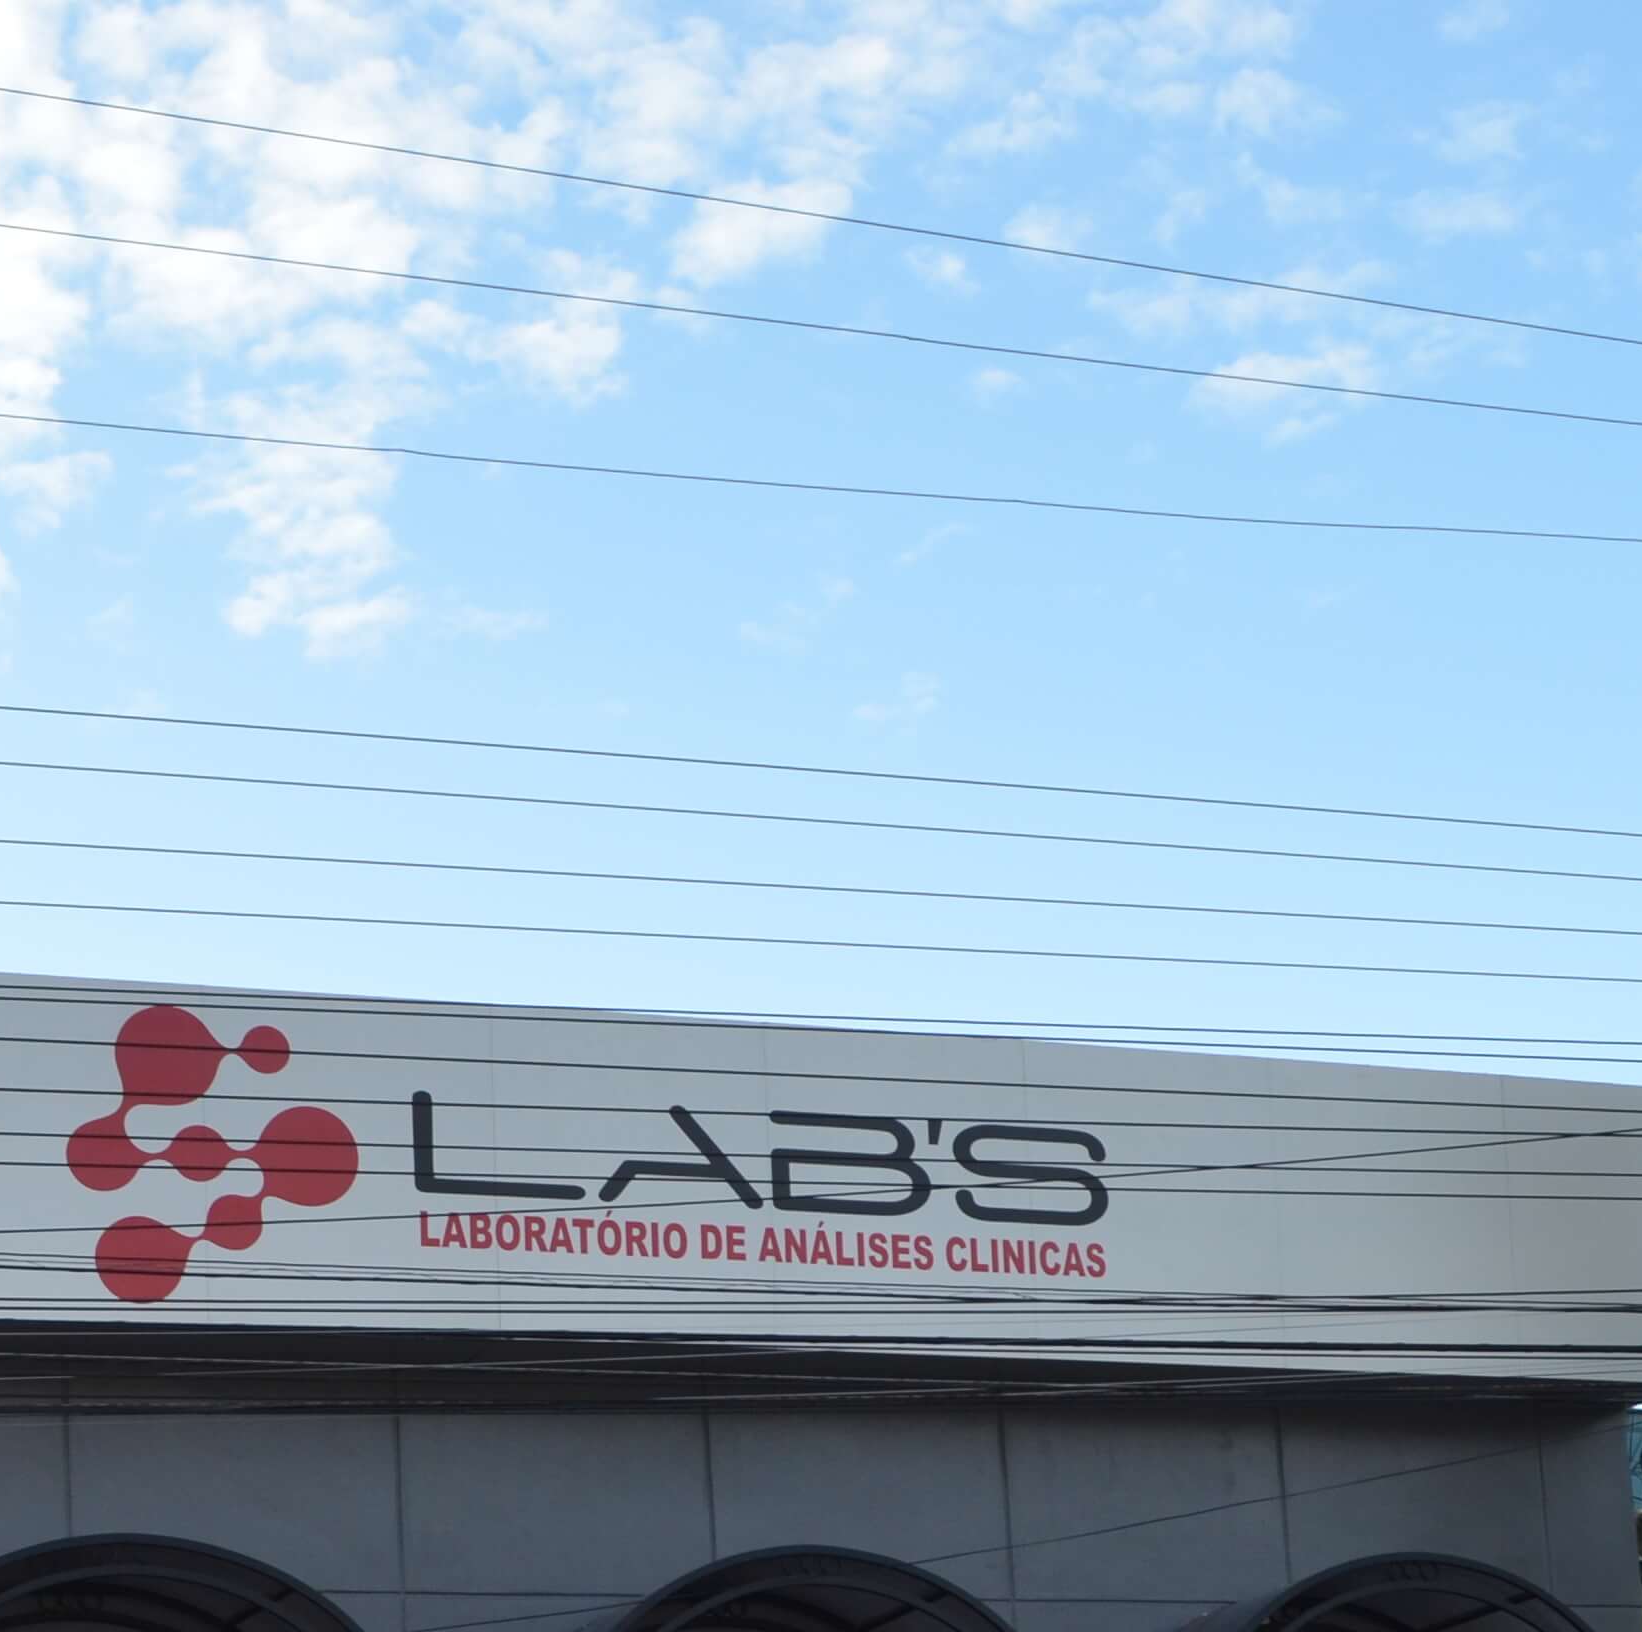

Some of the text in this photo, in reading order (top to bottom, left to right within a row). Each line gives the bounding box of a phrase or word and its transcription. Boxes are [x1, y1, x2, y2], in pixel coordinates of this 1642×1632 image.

[412, 1090, 1109, 1226] LAB'S
[419, 1210, 1107, 1278] LABORATÓRIO DE ANÁLISES CLINICAS
